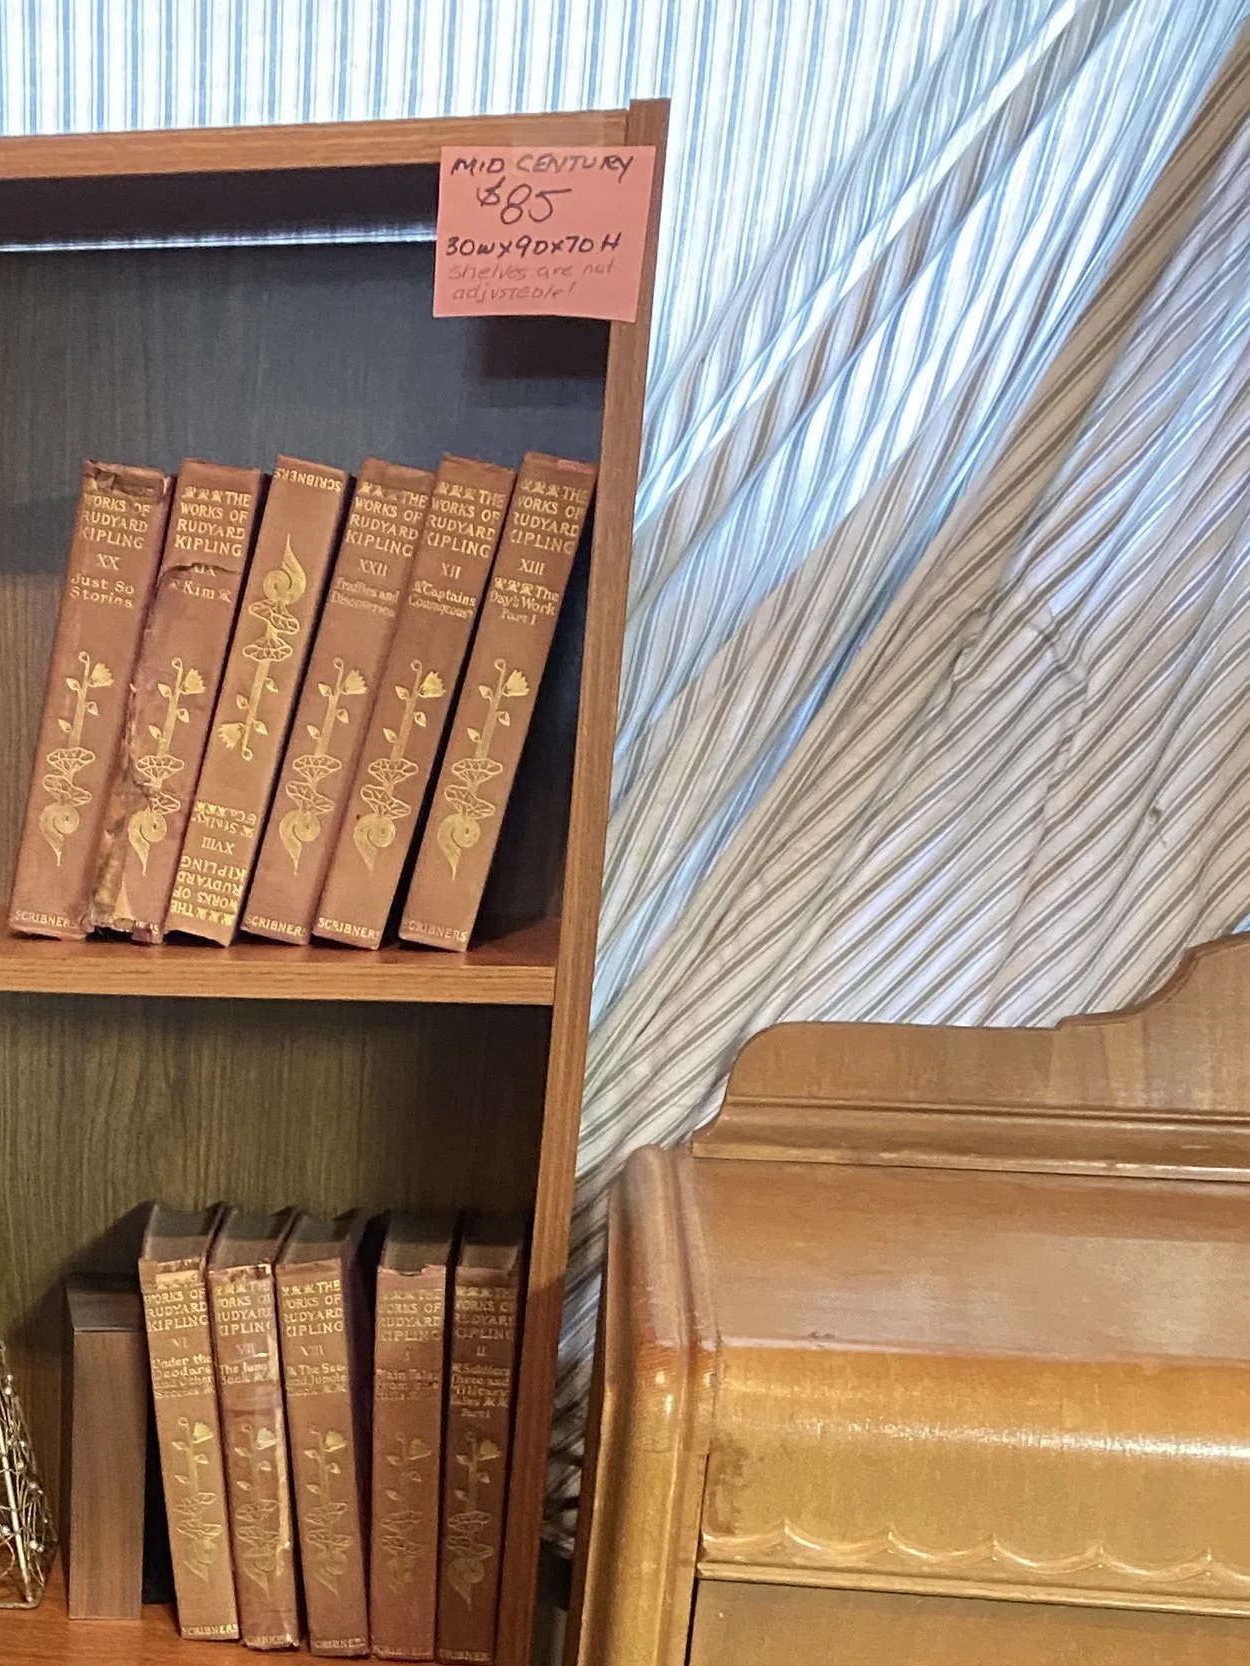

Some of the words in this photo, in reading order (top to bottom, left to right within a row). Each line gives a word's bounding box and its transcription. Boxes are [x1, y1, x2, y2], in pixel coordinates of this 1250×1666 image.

[451, 156, 504, 177] MID
[516, 153, 635, 184] CENTURY
[476, 175, 573, 225] $85
[536, 265, 574, 279] are
[274, 467, 343, 493] SCRIBNERS
[226, 491, 252, 508] THE
[401, 491, 429, 508] THE
[479, 489, 507, 508] THE
[181, 502, 223, 520] WORKS
[229, 510, 248, 525] OF
[355, 497, 398, 518] WORKS
[404, 510, 424, 524] OF
[432, 498, 475, 518] WORKS
[481, 510, 500, 524] OF
[83, 510, 148, 533] RUDYARD
[177, 518, 245, 541] RUDYARD
[350, 513, 419, 540] RUDYARD
[428, 515, 496, 541] RUDYARD
[174, 534, 242, 557] KIPLING
[345, 529, 414, 557] KIPLING
[96, 553, 121, 571] XX
[359, 558, 389, 577] XXII
[441, 562, 461, 580] XII
[519, 558, 546, 576] XIII
[70, 573, 107, 591] Just
[115, 580, 135, 595] So
[183, 579, 216, 600] Kim
[537, 585, 560, 602] The
[70, 586, 134, 609] Stories
[522, 597, 556, 616] Work
[201, 836, 236, 855] XVIII
[180, 856, 247, 882] KIPLING
[173, 886, 192, 899] OF
[177, 871, 244, 897] RUDYARD
[170, 900, 194, 918] THE
[196, 892, 239, 912] WORKS
[190, 1288, 206, 1300] OF
[317, 1280, 341, 1293] THE
[148, 1301, 208, 1318] RUDYARD
[325, 1294, 342, 1305] OF
